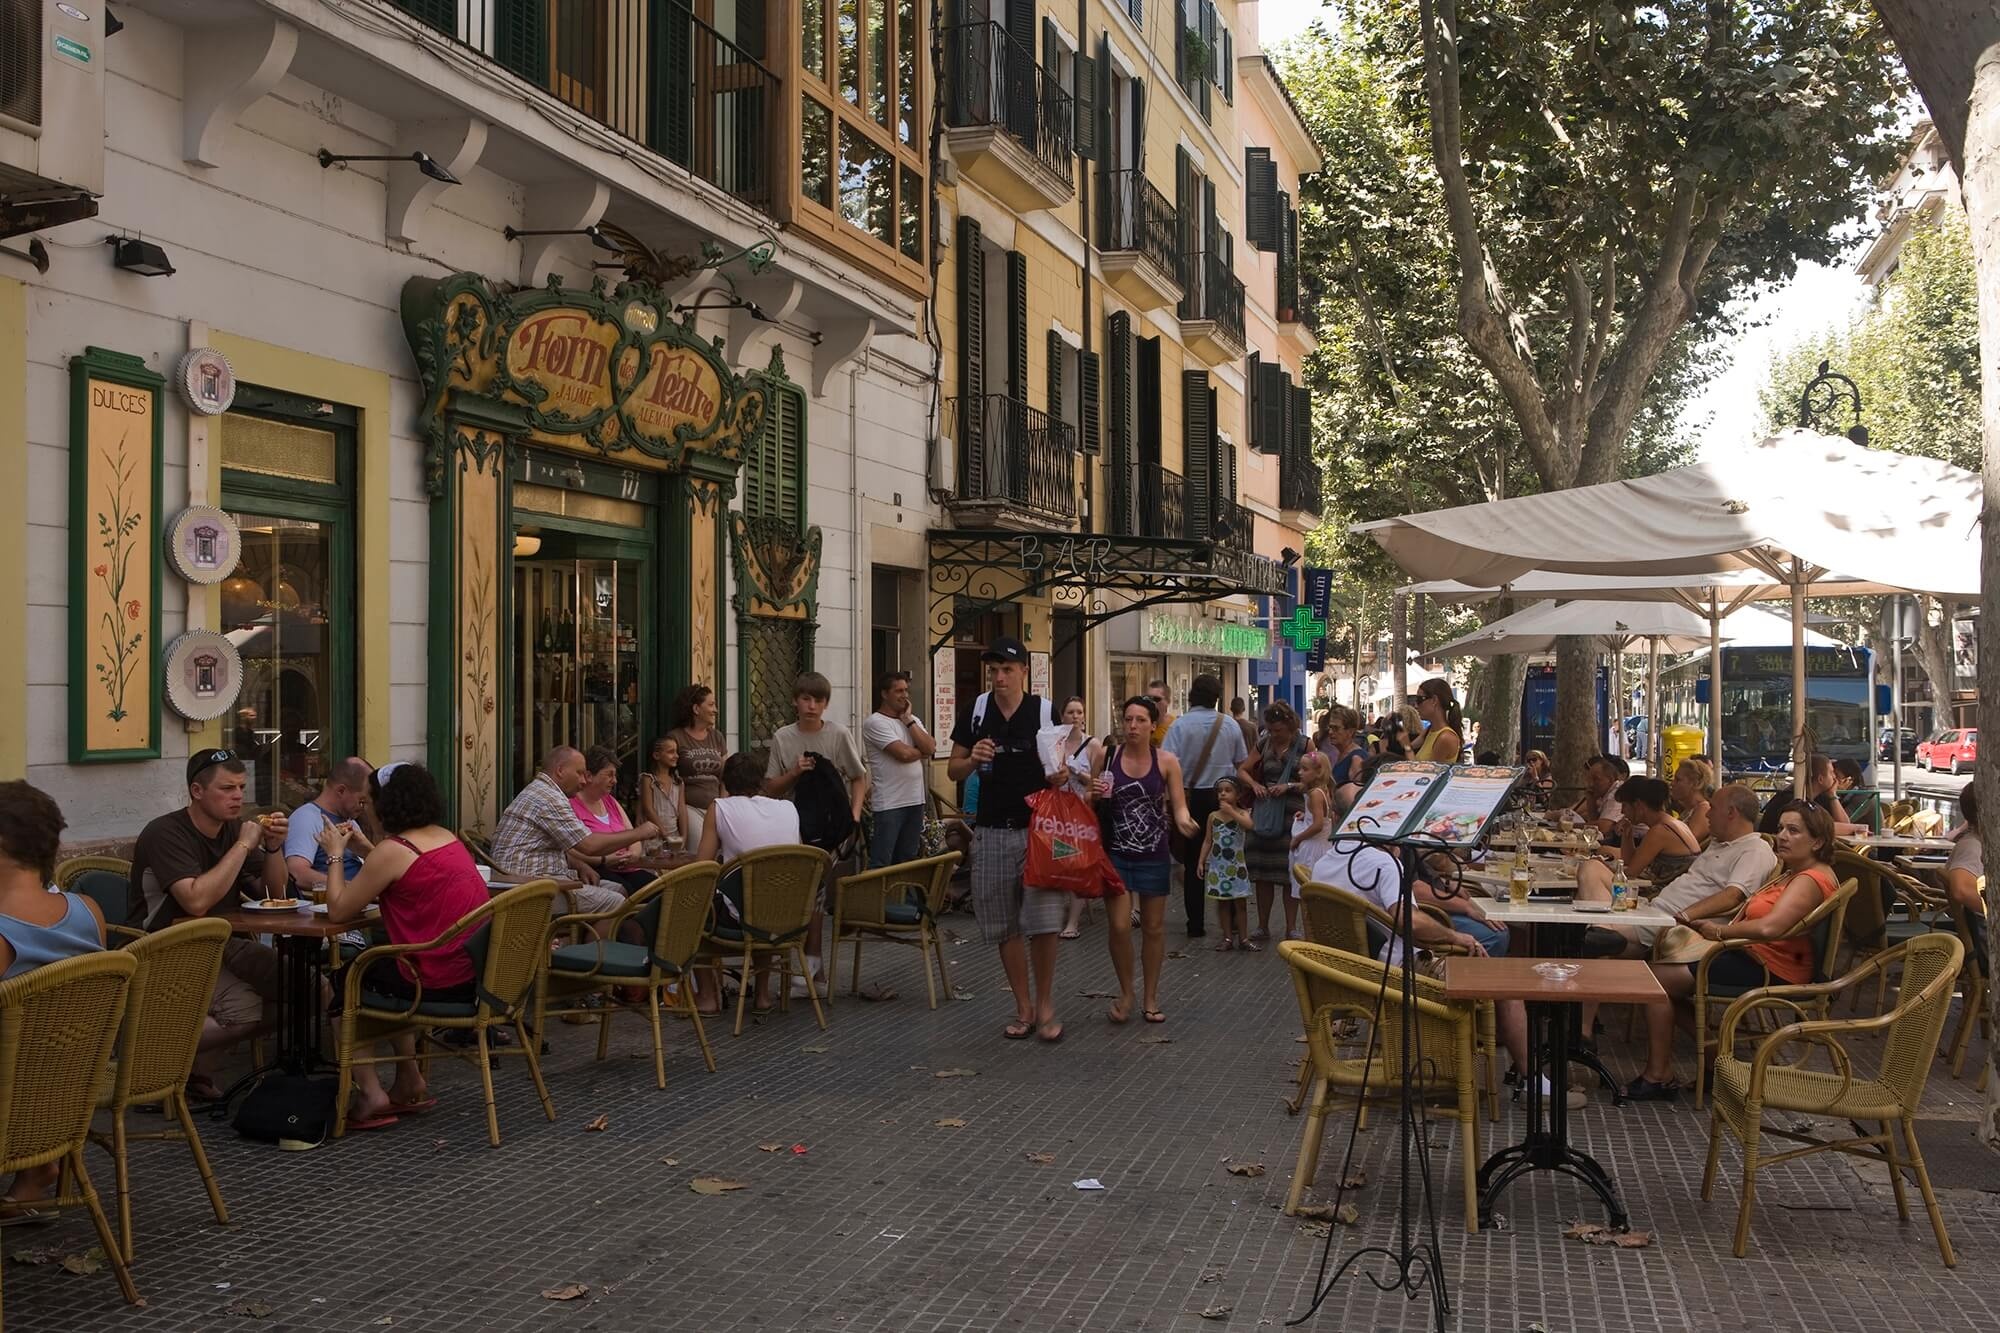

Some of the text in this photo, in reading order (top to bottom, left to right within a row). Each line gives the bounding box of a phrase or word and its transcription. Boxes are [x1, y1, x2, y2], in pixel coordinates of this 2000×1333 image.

[518, 315, 714, 424] Forn des Teatre
[93, 387, 147, 415] DULCES
[555, 383, 595, 407] JAUME
[607, 419, 616, 436] 9
[1012, 535, 1116, 575] BAR
[1034, 815, 1098, 842] rebajas
